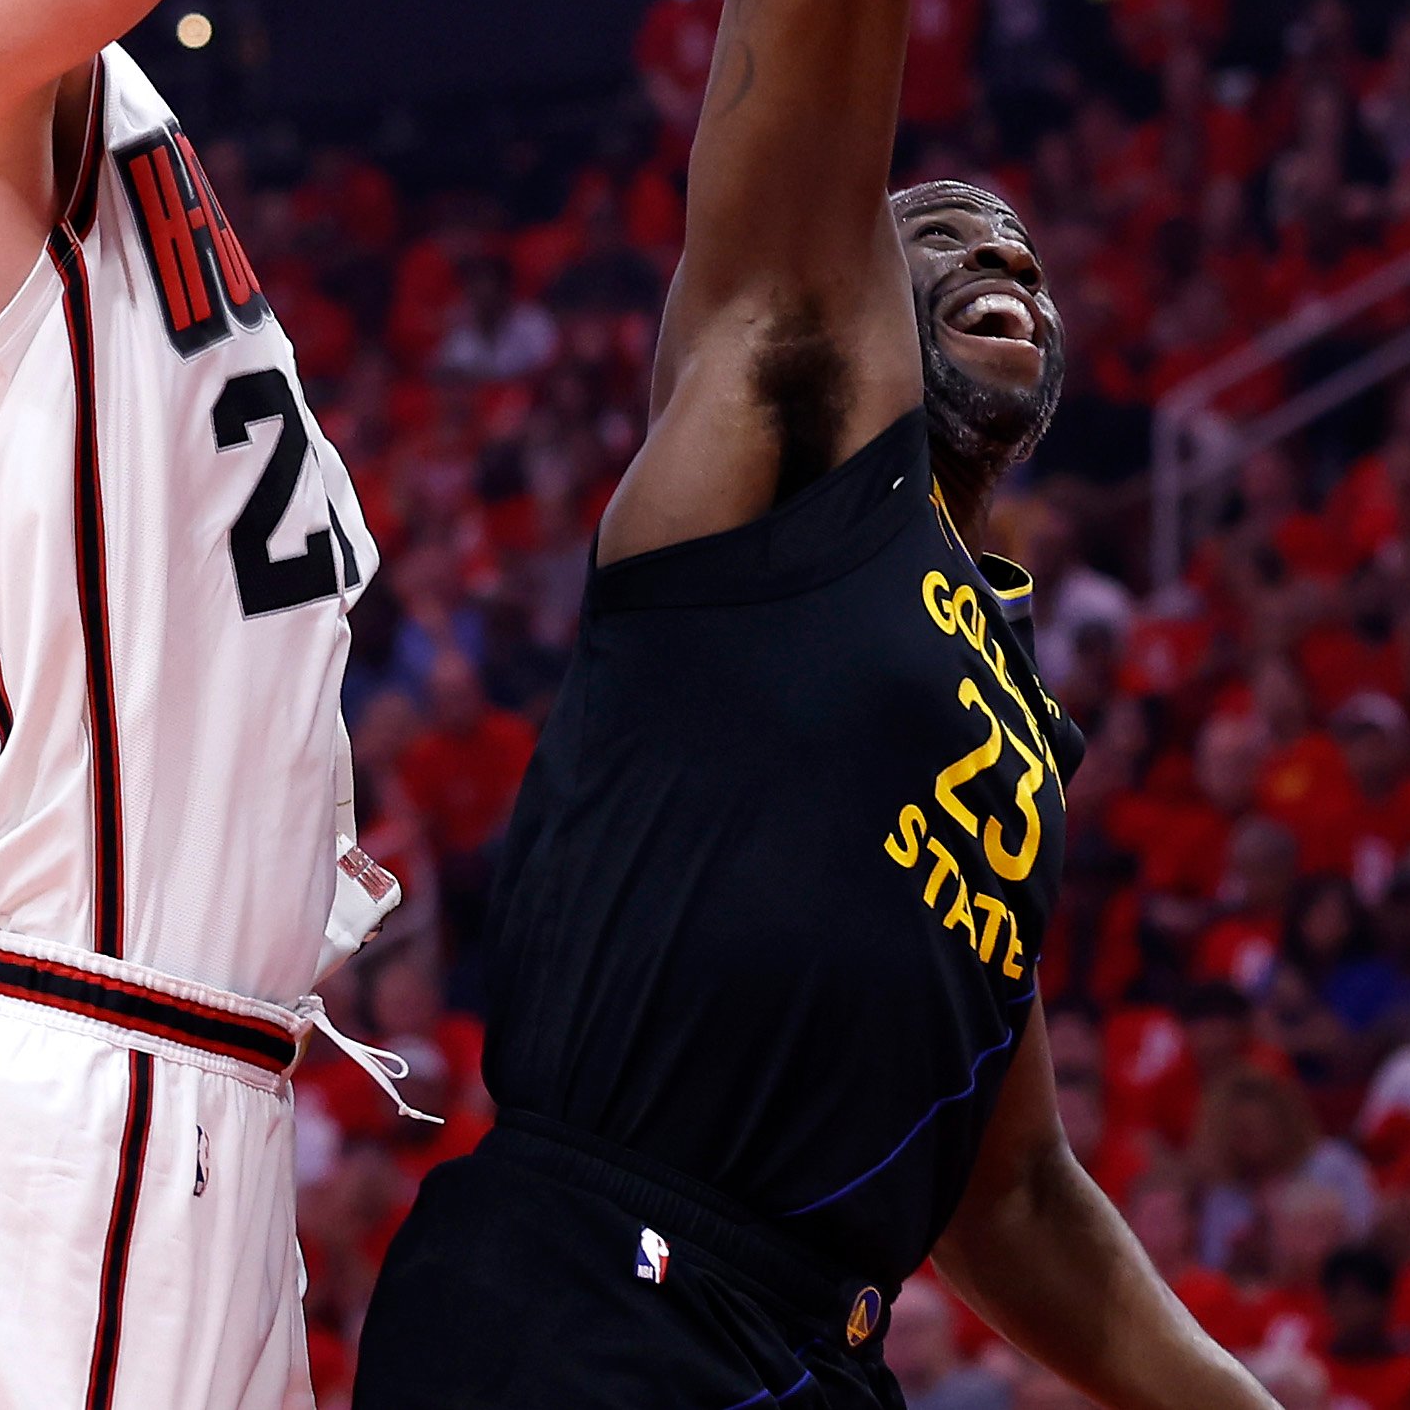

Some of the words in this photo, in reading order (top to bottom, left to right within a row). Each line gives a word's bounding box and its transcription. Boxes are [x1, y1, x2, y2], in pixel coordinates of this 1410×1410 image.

[210, 367, 364, 622] 2
[934, 676, 1044, 882] 23
[883, 803, 1024, 981] STATE
